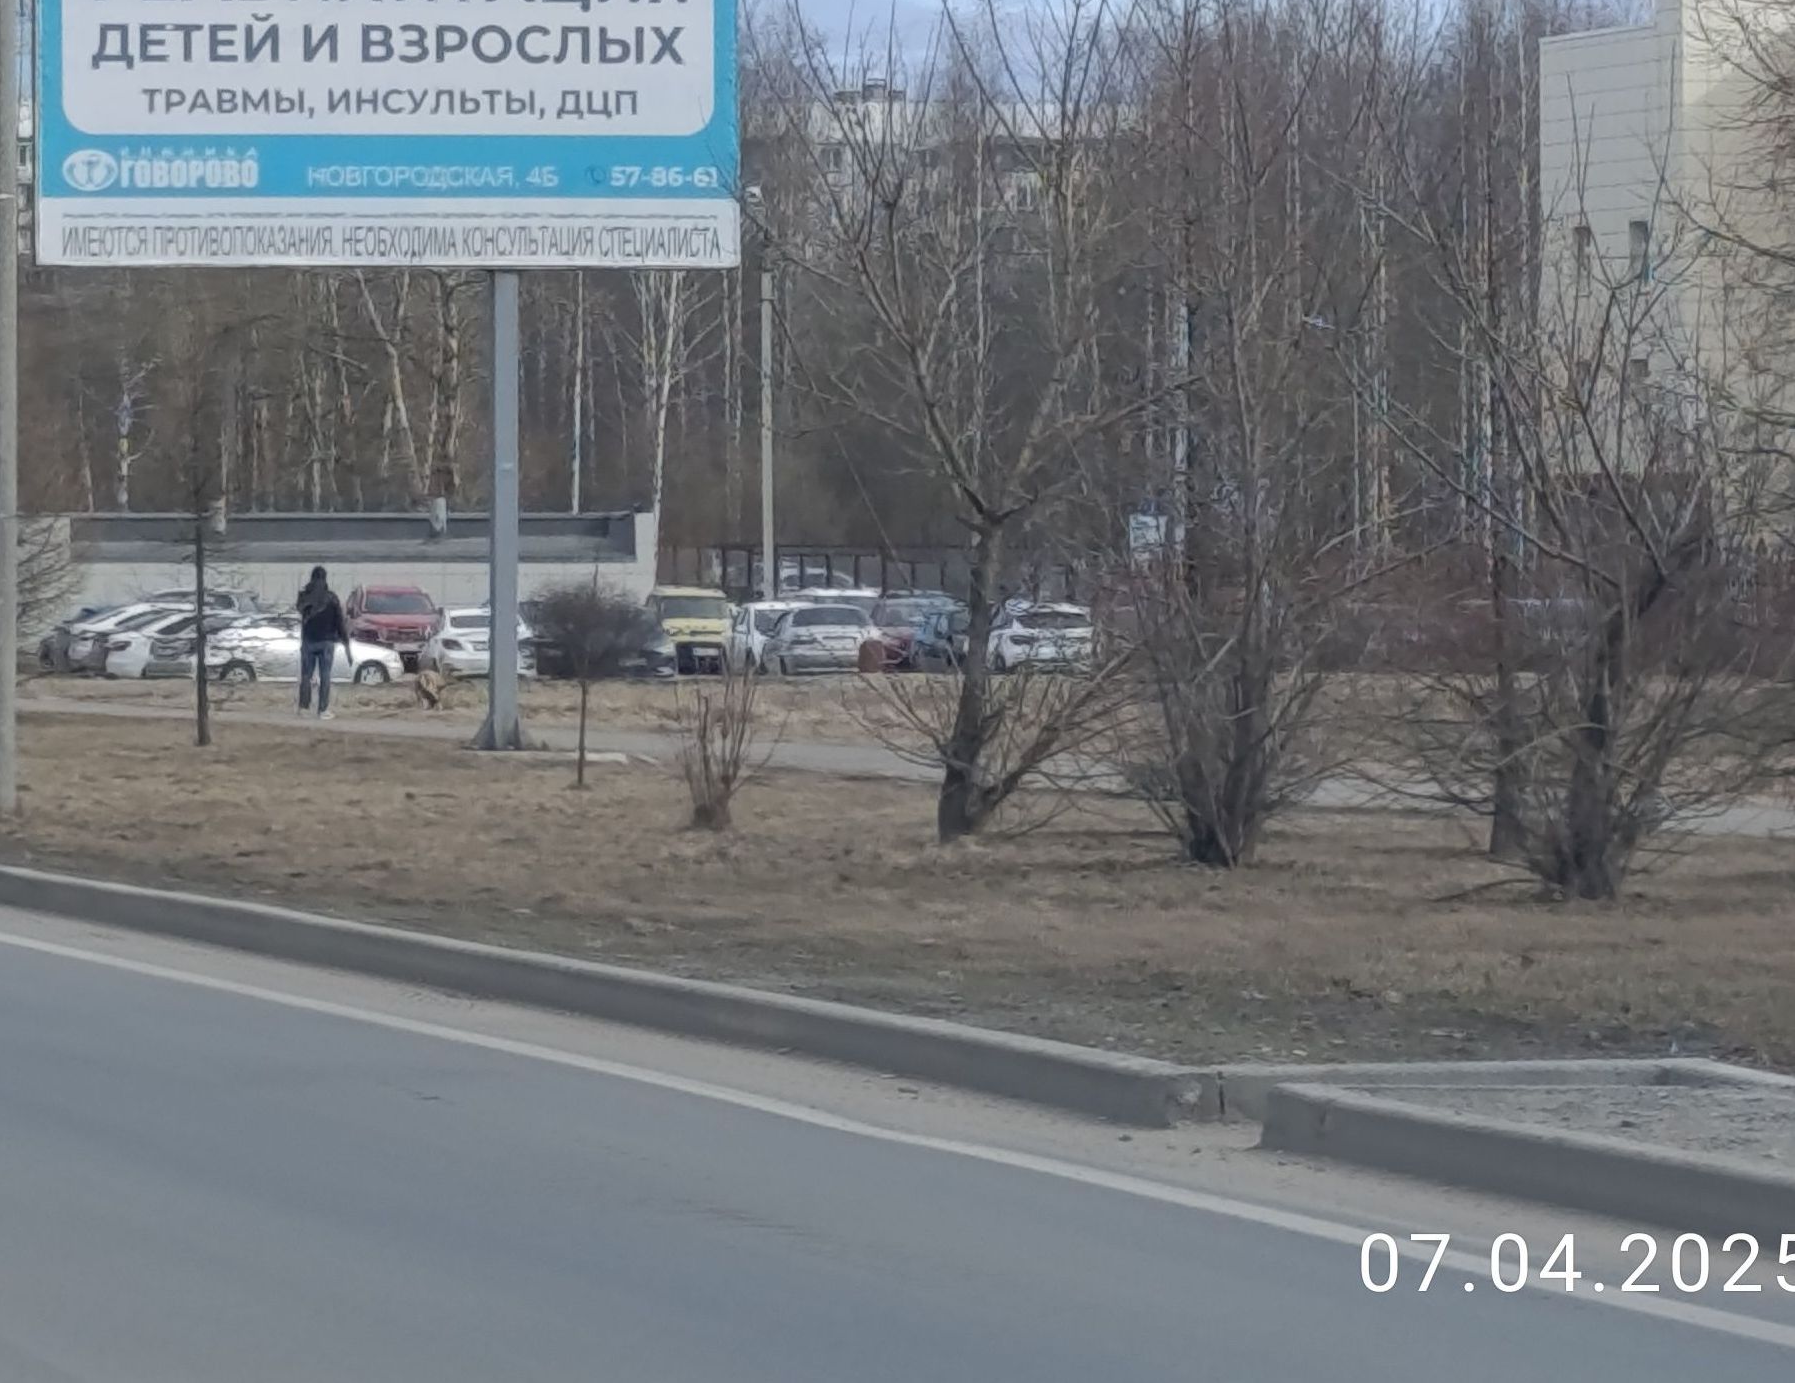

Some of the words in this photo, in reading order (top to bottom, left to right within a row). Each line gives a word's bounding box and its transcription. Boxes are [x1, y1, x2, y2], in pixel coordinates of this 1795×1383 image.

[91, 13, 280, 70] ДЕТЕЙ
[302, 22, 339, 63] И
[360, 22, 686, 66] ВЗРОСЛЫХ
[141, 87, 316, 119] ТРАВМЫ,
[326, 87, 546, 120] ИНСУЛЬТЫ,
[555, 88, 639, 120] ДЦП
[119, 158, 260, 189] ГОВОРОВО
[307, 165, 521, 190] НОВГОРОДСКАЯ,
[525, 166, 561, 188] 4Б
[609, 166, 719, 189] 57-86-61
[61, 224, 148, 259] ИМЕЮТСЯ
[341, 224, 457, 264] НЕОБХОДИМА
[461, 224, 594, 259] КОНСУЛЬТАЦИЯ
[597, 224, 722, 264] СПЕЦИАЛИСТА
